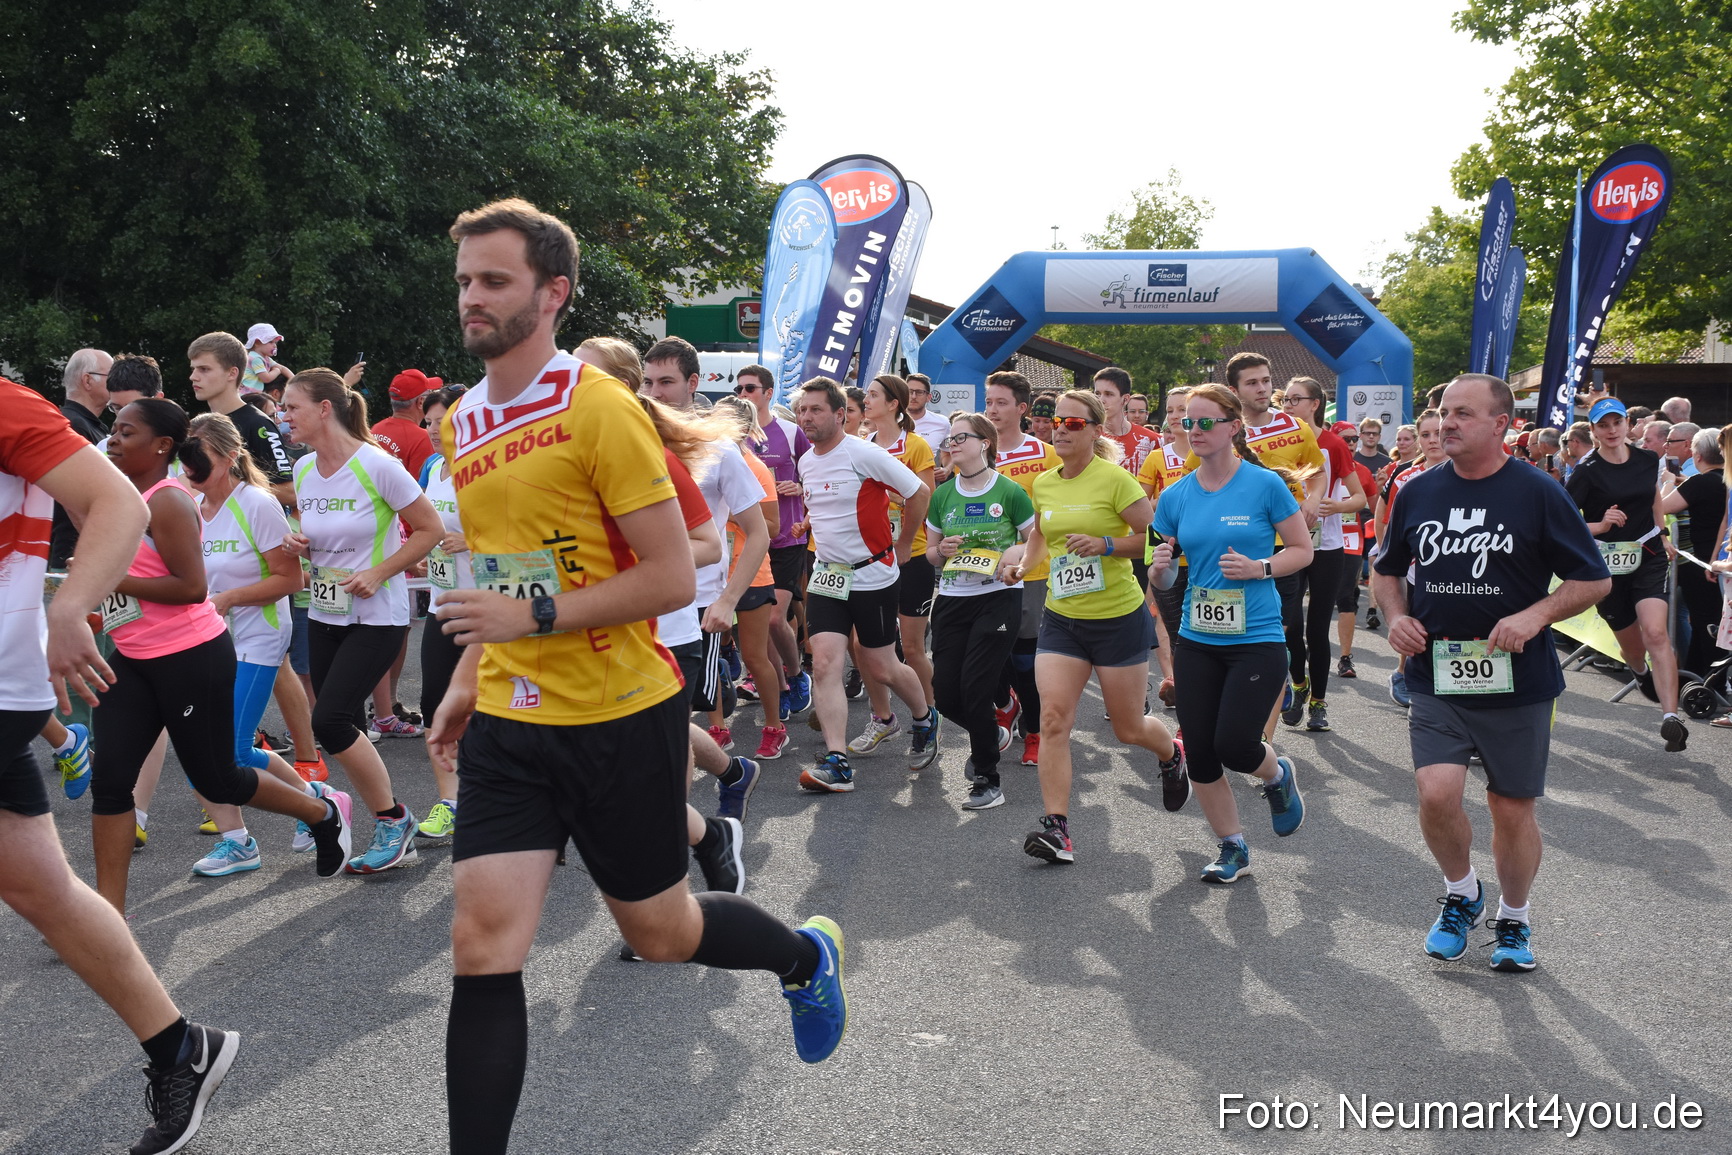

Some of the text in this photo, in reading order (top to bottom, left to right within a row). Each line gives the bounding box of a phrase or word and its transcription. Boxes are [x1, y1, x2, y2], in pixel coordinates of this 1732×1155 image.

[1597, 176, 1659, 209] Hervis
[834, 208, 857, 217] ORTS
[1604, 205, 1629, 215] SPORTS
[898, 211, 920, 278] AUTOMOBILE
[1486, 200, 1506, 286] Fischer
[1156, 271, 1185, 280] Fischer
[818, 230, 888, 376] ETMOVIN
[1133, 287, 1220, 303] firmenlauf
[970, 316, 1016, 327] Fischer
[373, 433, 401, 454] NGER SV
[1267, 434, 1305, 451] BÖGL
[454, 423, 572, 493] MAX BÖGL
[1010, 463, 1048, 477] BÖGL
[1166, 471, 1182, 479] MA
[1416, 520, 1514, 579] Burgis
[952, 555, 991, 567] 2088
[1604, 553, 1637, 566] 1870
[813, 571, 846, 589] 2089
[1056, 564, 1096, 586] 1294
[313, 581, 336, 601] 921
[1425, 581, 1504, 595] Knödelliebe.
[1195, 603, 1235, 622] 1861
[1450, 659, 1493, 679] 390
